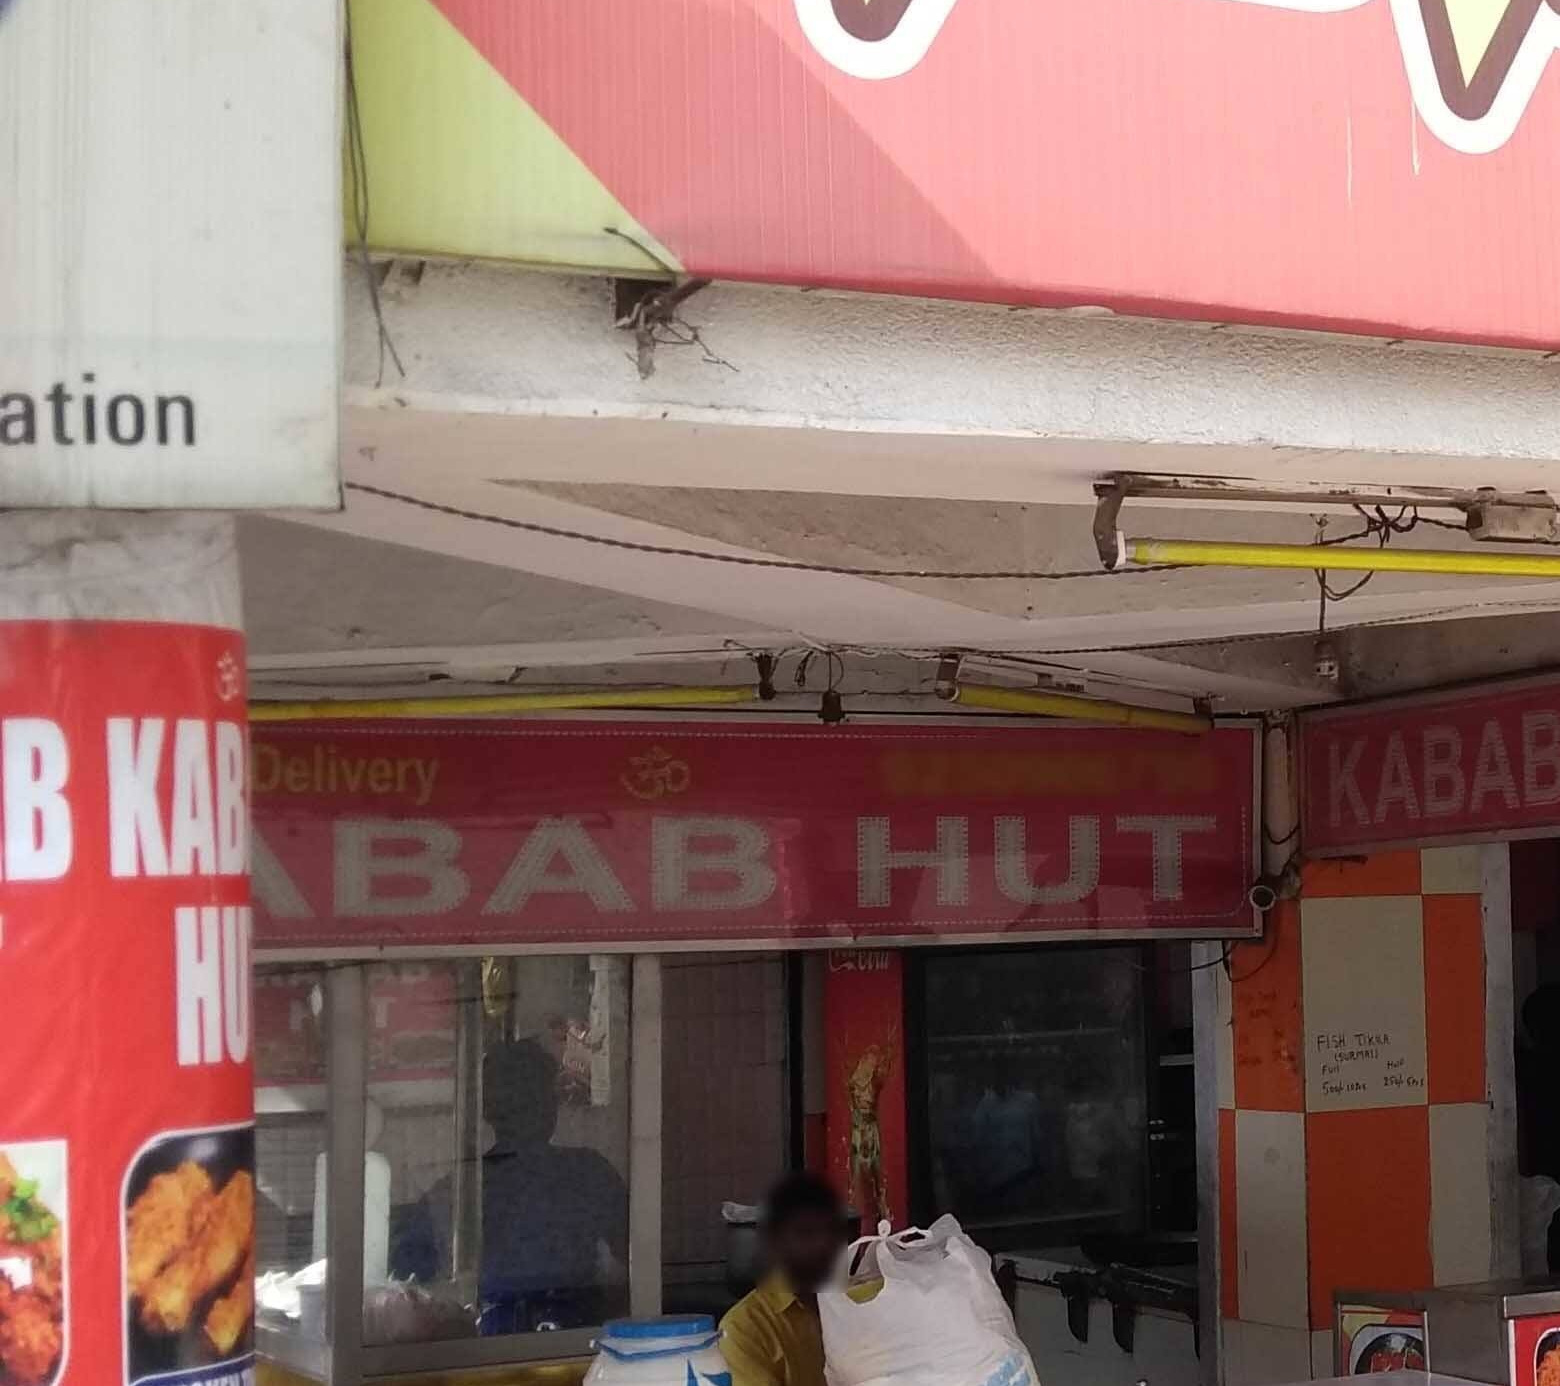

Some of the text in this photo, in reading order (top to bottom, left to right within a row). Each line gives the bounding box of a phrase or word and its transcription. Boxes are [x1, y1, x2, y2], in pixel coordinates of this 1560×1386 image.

[0, 373, 195, 446] ation
[252, 742, 440, 806] Delivery
[856, 815, 1218, 909] HUT
[1316, 1032, 1345, 1052] FISH
